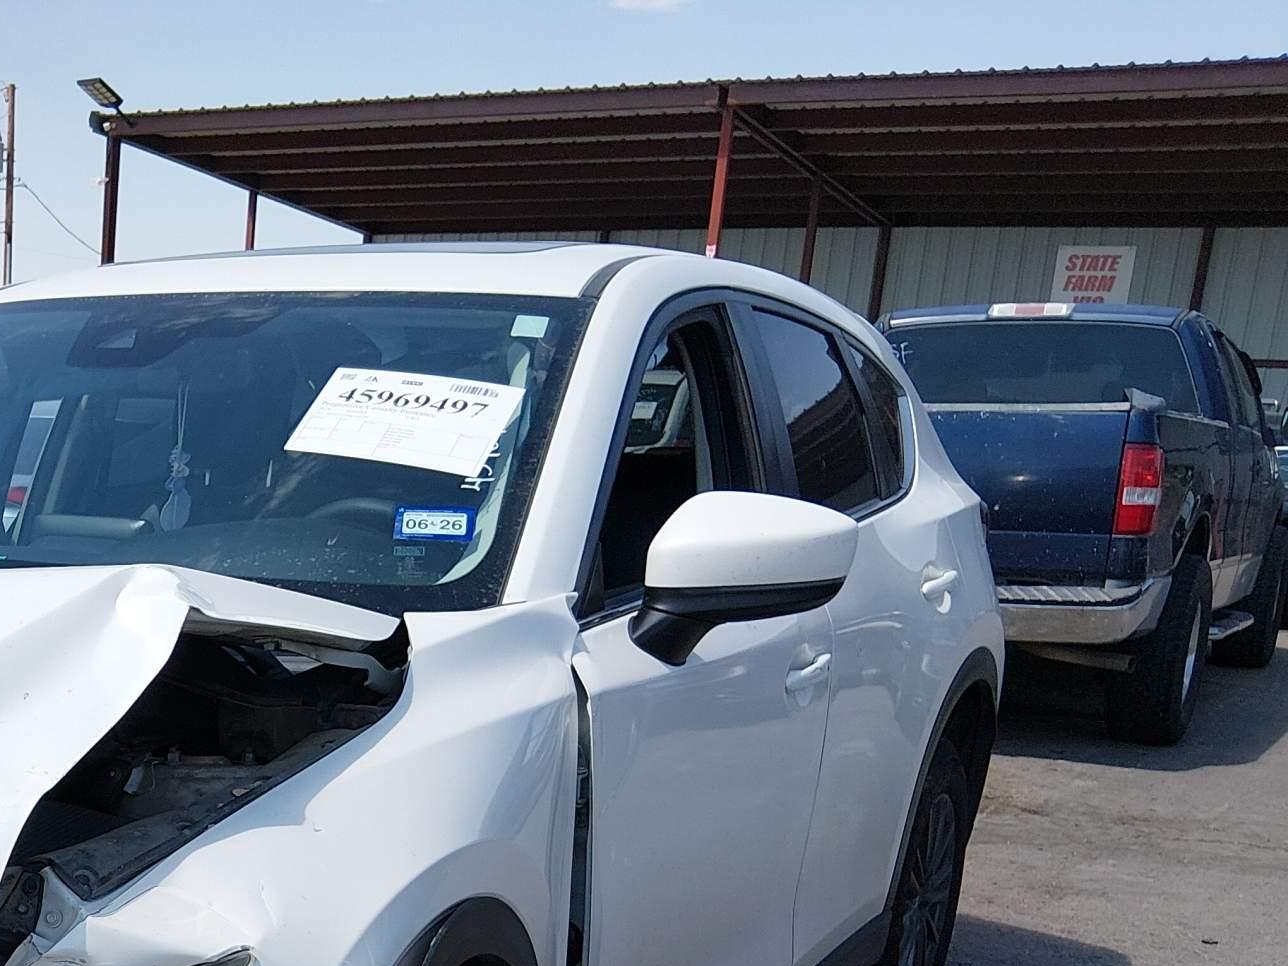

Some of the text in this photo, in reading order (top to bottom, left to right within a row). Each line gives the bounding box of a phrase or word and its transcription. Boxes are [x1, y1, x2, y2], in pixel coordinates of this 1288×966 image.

[1065, 254, 1122, 272] STATE
[1062, 275, 1116, 292] FARM
[338, 387, 489, 417] 45969497
[405, 519, 463, 531] 06 26
